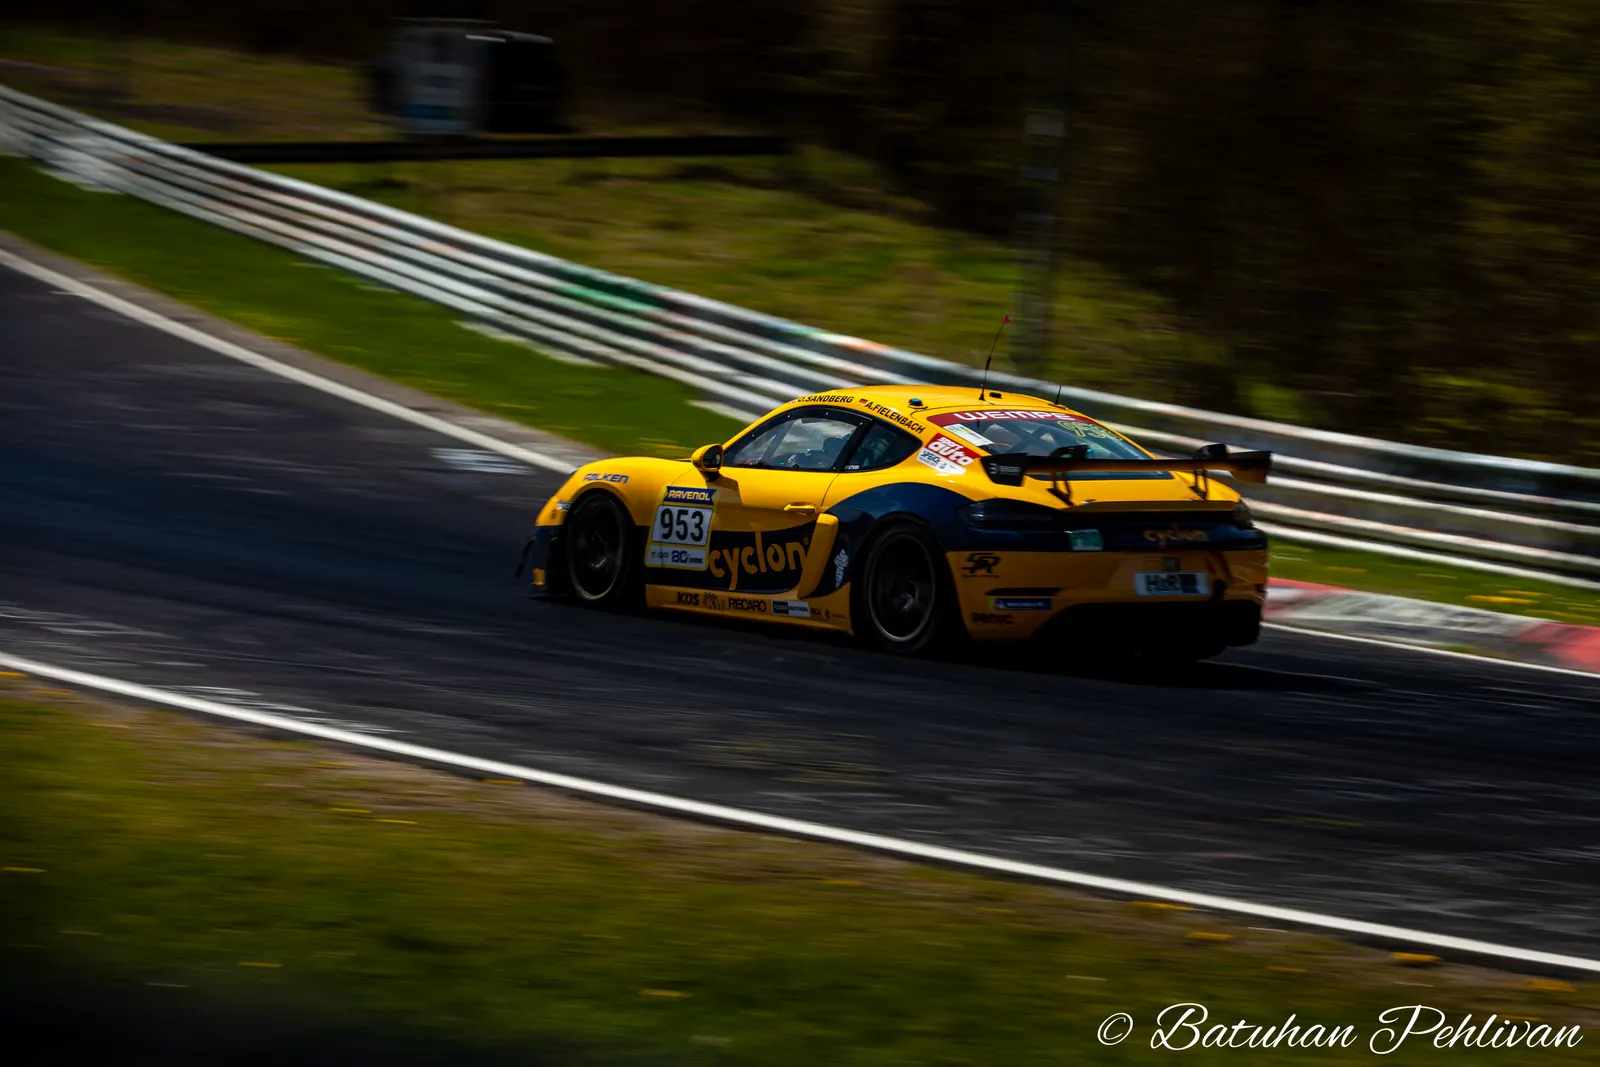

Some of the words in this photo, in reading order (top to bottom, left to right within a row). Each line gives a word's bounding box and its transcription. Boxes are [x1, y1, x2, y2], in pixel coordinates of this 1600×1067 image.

[864, 401, 926, 434] A.FIELENBACH
[953, 410, 1076, 422] WEMPE
[928, 441, 974, 466] auto
[582, 473, 630, 485] FALKEN
[667, 489, 711, 501] RAVENOL
[659, 507, 704, 542] 953
[709, 531, 808, 590] cyclon
[728, 598, 767, 612] RECARO
